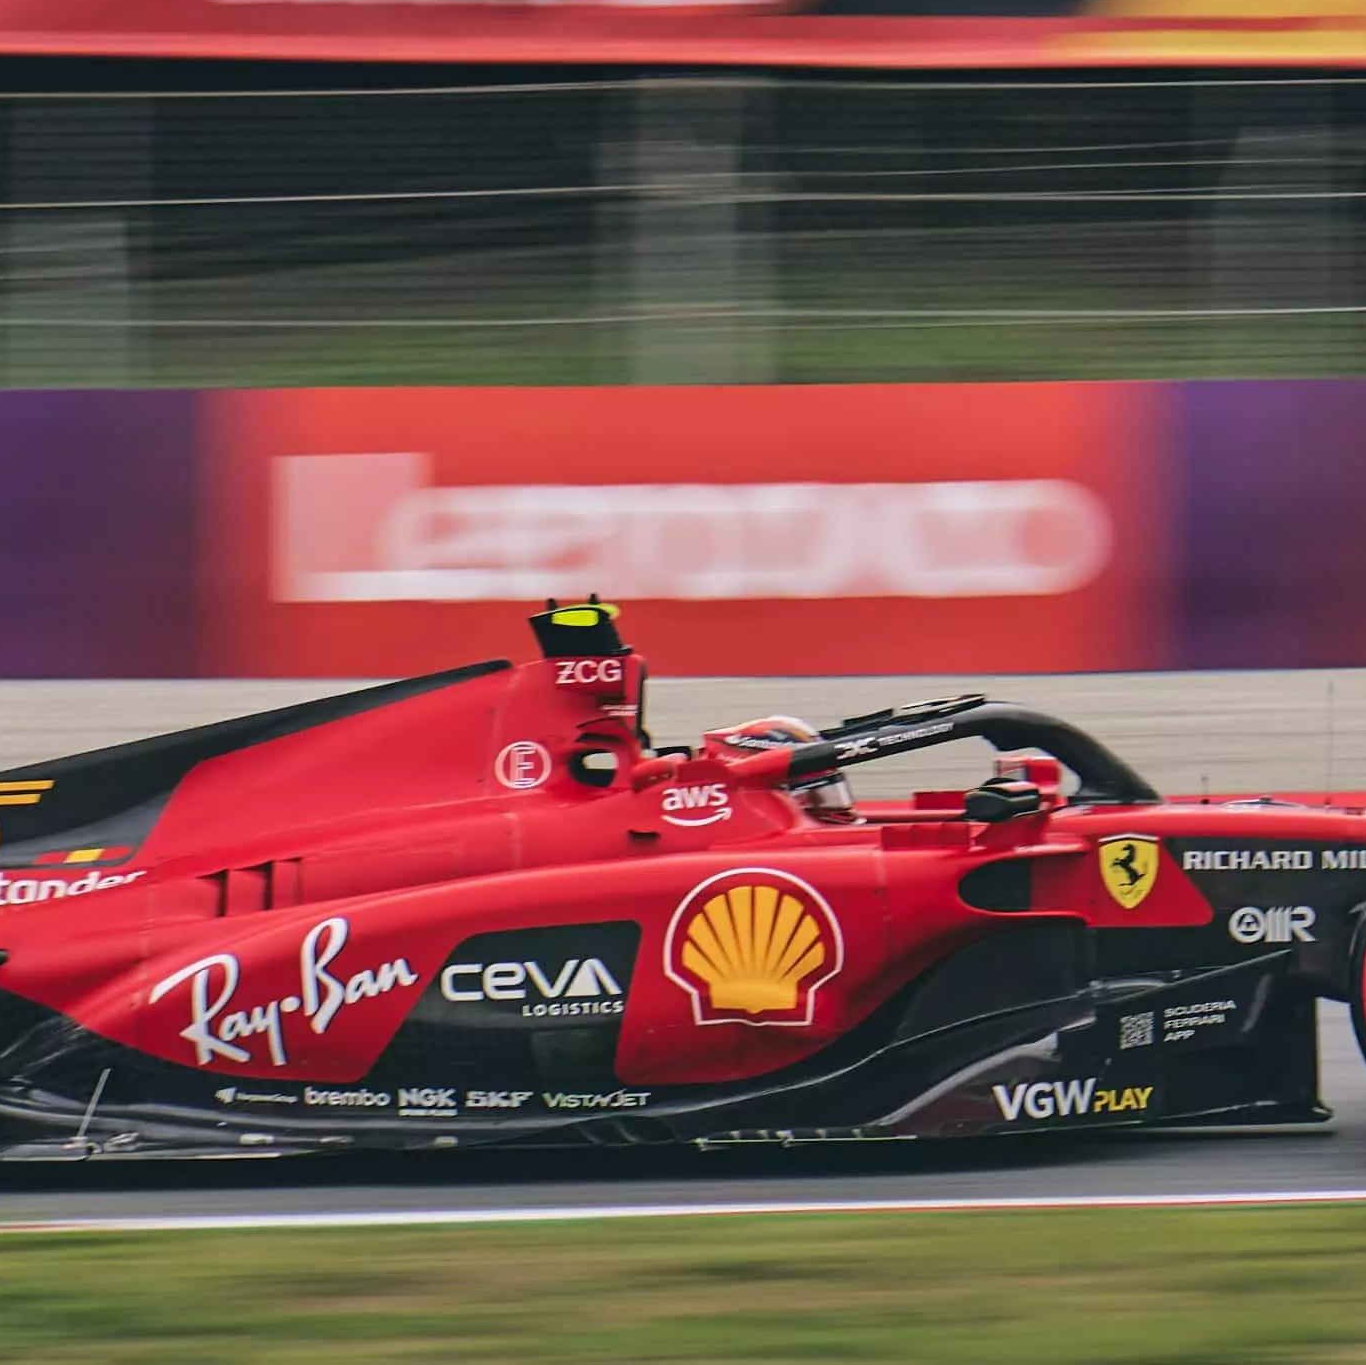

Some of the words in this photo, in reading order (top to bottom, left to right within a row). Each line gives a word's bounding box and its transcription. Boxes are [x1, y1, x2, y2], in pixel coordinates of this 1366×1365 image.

[555, 659, 622, 684] ZCG
[662, 783, 729, 811] aws
[1183, 850, 1313, 870] RICHARD
[521, 1000, 624, 1017] LOGISTICS
[303, 1086, 391, 1107] brembo
[397, 1087, 457, 1108] NGK
[993, 1078, 1097, 1121] VGW
[1094, 1086, 1154, 1113] PLAY
